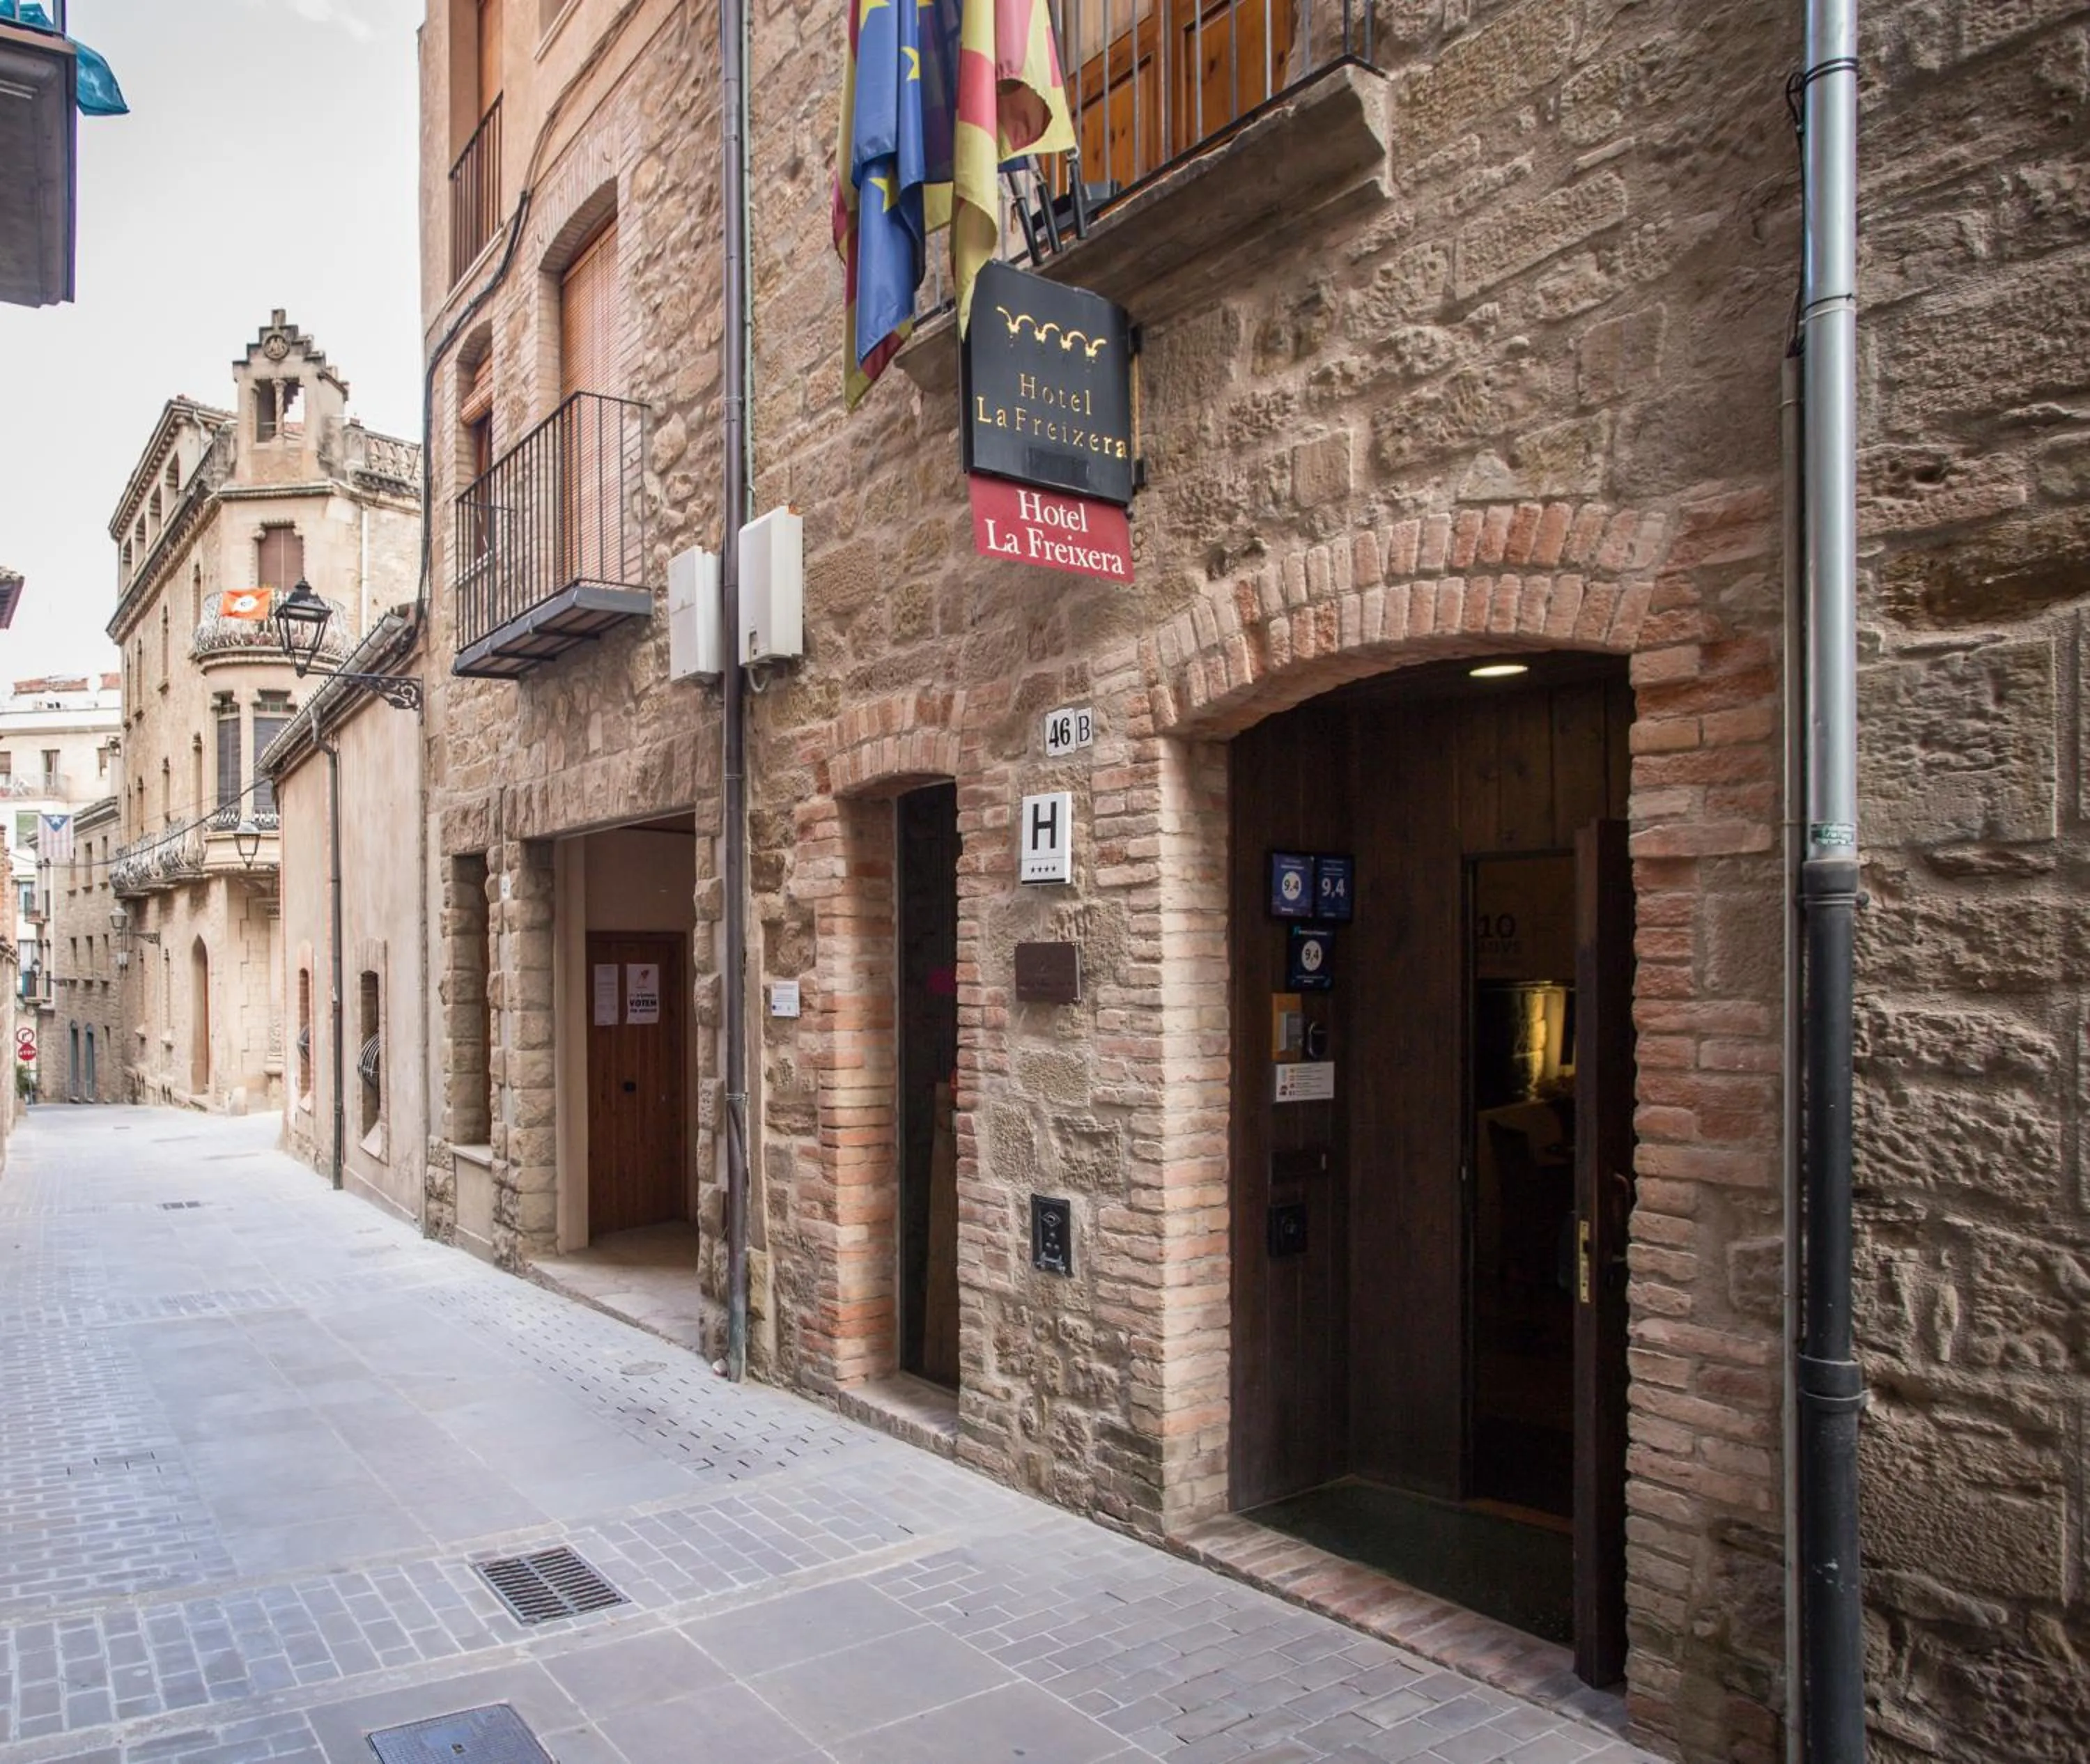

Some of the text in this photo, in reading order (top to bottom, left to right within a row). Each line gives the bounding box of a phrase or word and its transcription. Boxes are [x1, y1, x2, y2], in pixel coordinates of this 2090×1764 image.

[1020, 373, 1091, 415] Hotel
[1017, 490, 1090, 534] Hotel
[984, 518, 1125, 575] La Freixera
[1048, 715, 1090, 748] 46 B
[1032, 801, 1057, 851] H
[1322, 878, 1345, 899] 9,4
